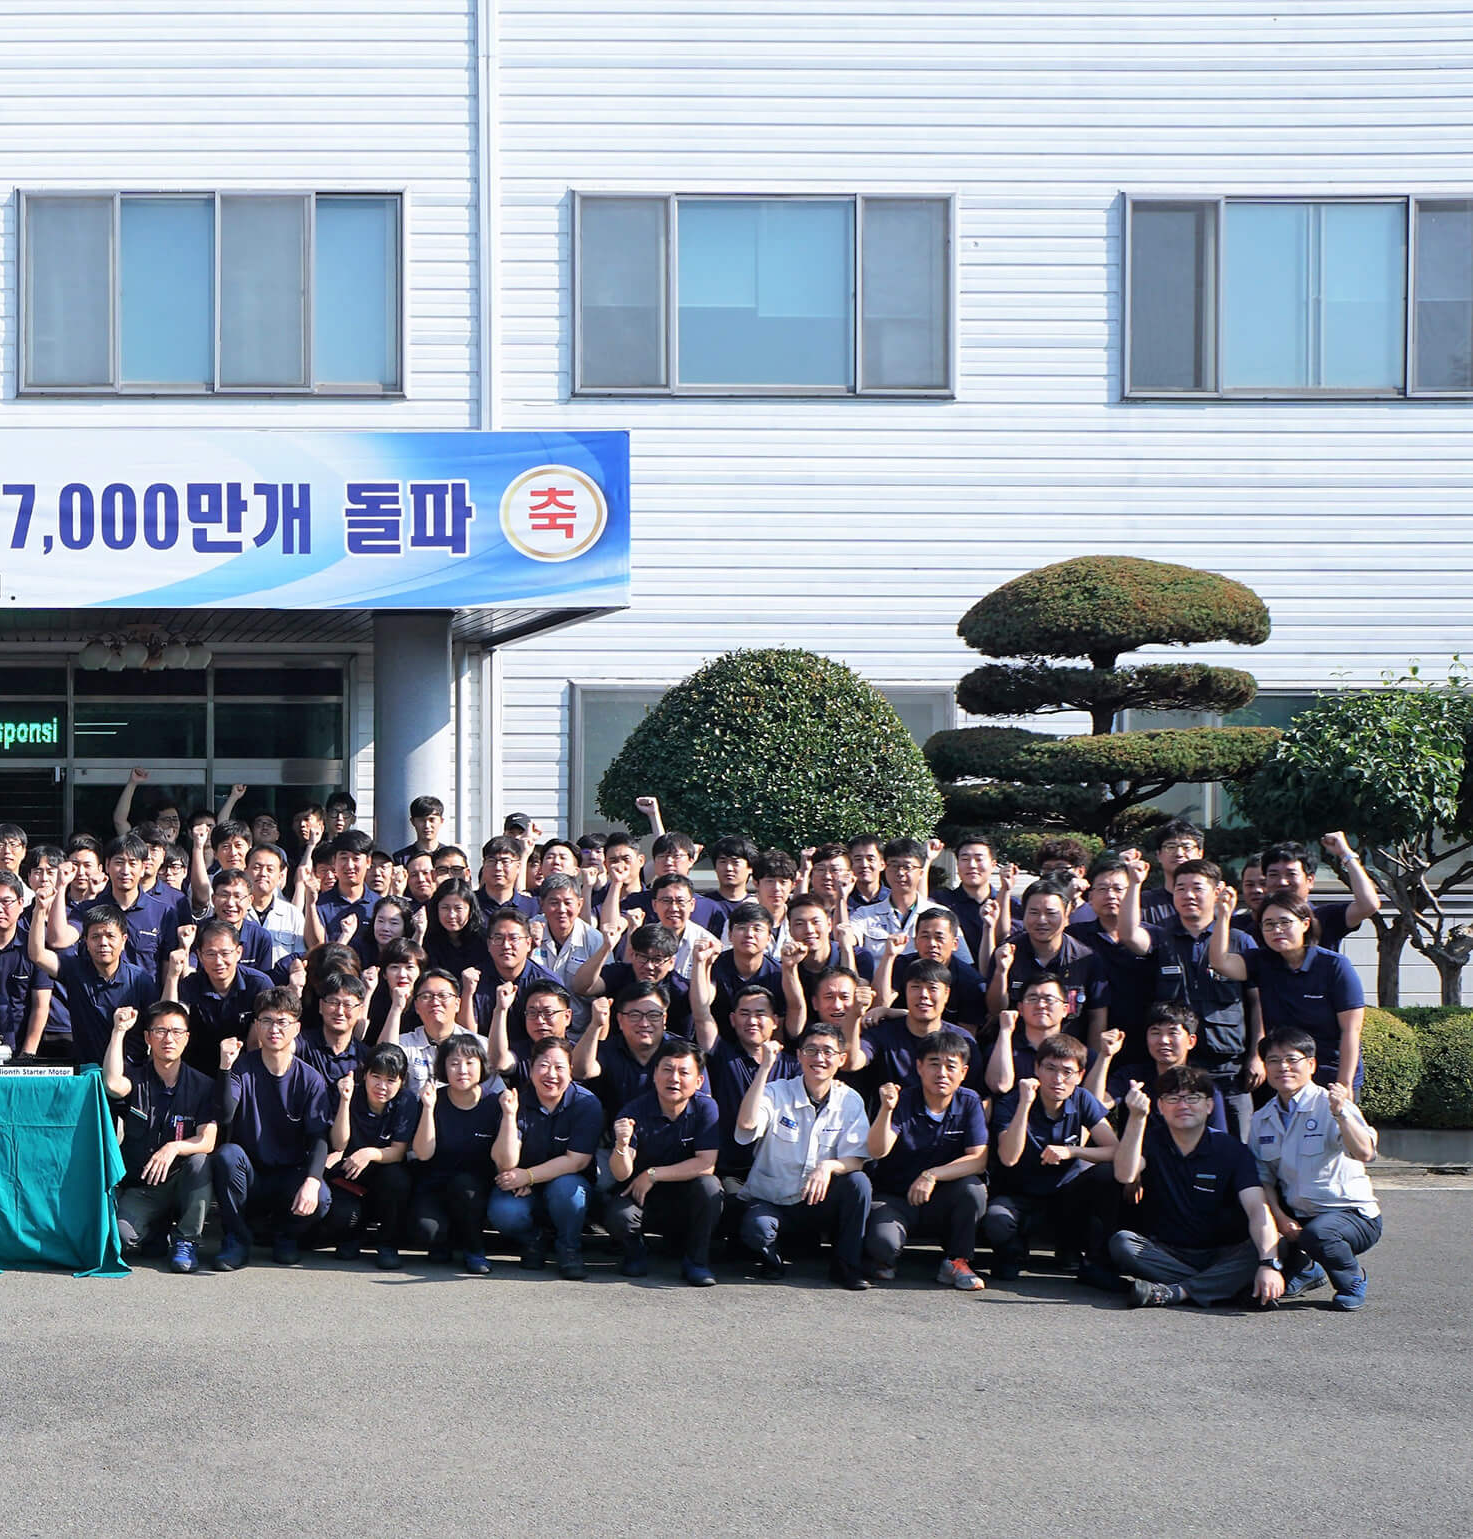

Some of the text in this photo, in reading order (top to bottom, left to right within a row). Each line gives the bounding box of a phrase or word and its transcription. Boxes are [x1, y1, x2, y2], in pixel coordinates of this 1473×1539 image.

[2, 482, 311, 555] 7,000만개
[345, 482, 472, 556] 돌파
[528, 487, 577, 539] 축
[22, 1067, 46, 1076] Starter
[48, 1067, 71, 1076] Motor
